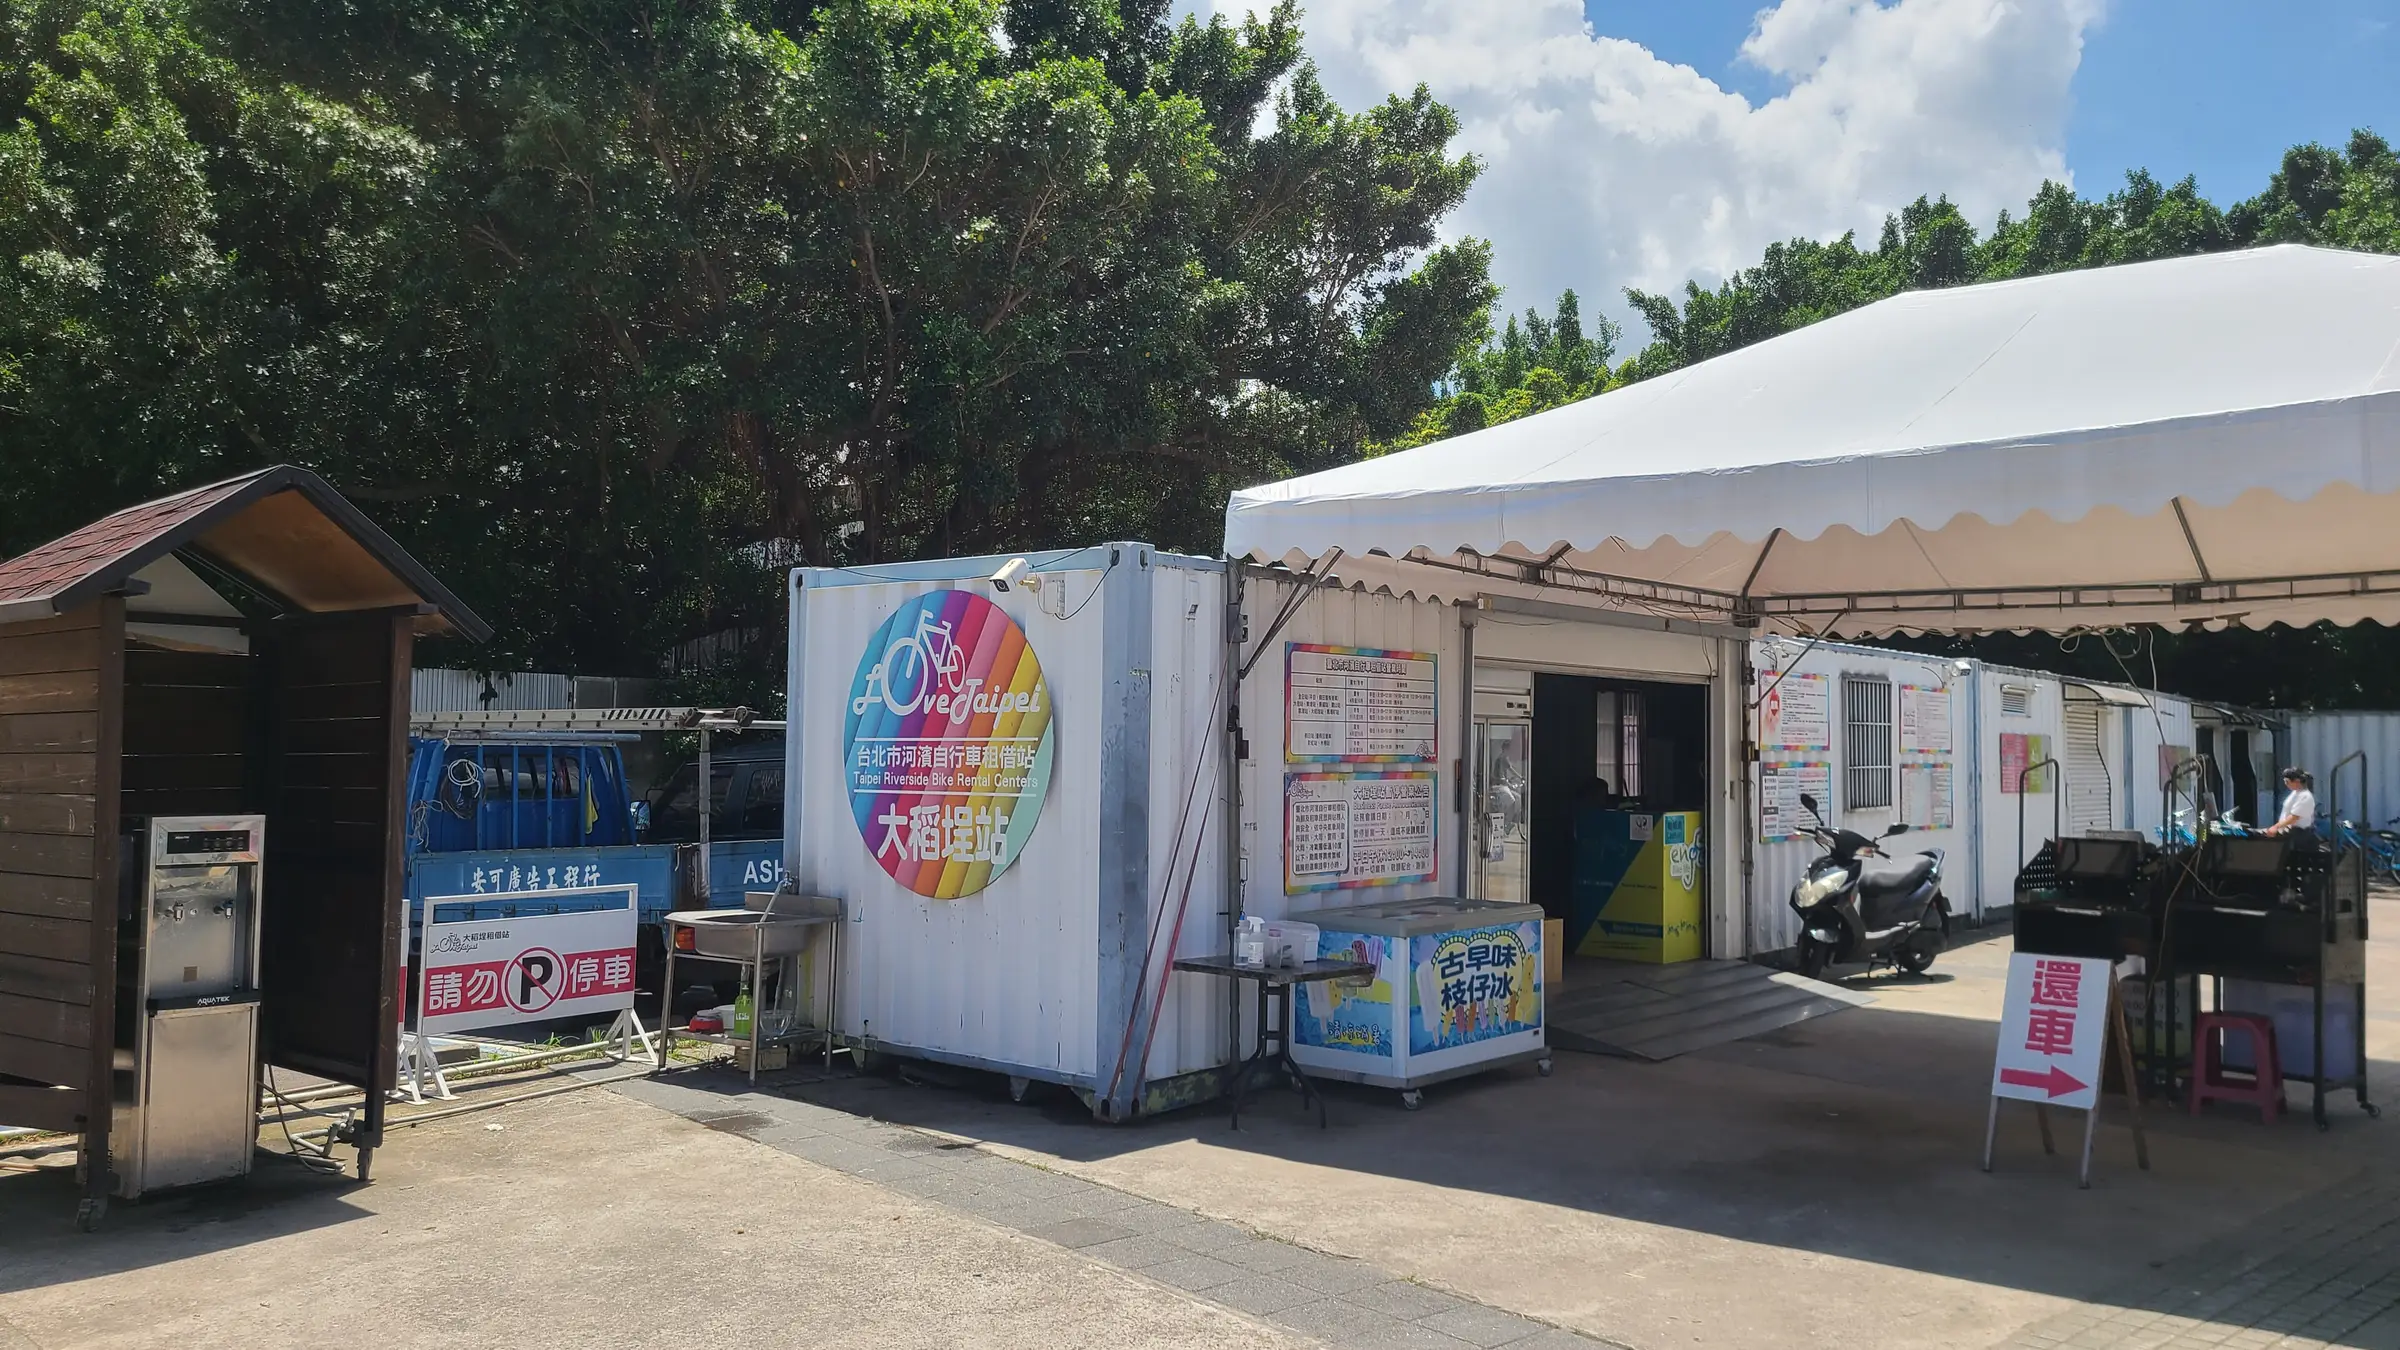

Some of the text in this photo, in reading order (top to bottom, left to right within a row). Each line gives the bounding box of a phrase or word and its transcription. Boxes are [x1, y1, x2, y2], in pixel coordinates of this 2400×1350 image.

[856, 745, 1036, 769] 台北市河濱自行車租借站
[853, 772, 1038, 788] Taipei Riverside Bike Rental Centers
[877, 802, 1009, 864] 大稻埕站
[471, 864, 601, 894] 安可廣告工程行
[1437, 943, 1517, 979] 古早味
[429, 969, 498, 1010] 請勿
[570, 954, 632, 994] 停車
[1440, 972, 1514, 1011] 枝仔冰
[2024, 959, 2082, 1056] 還車
